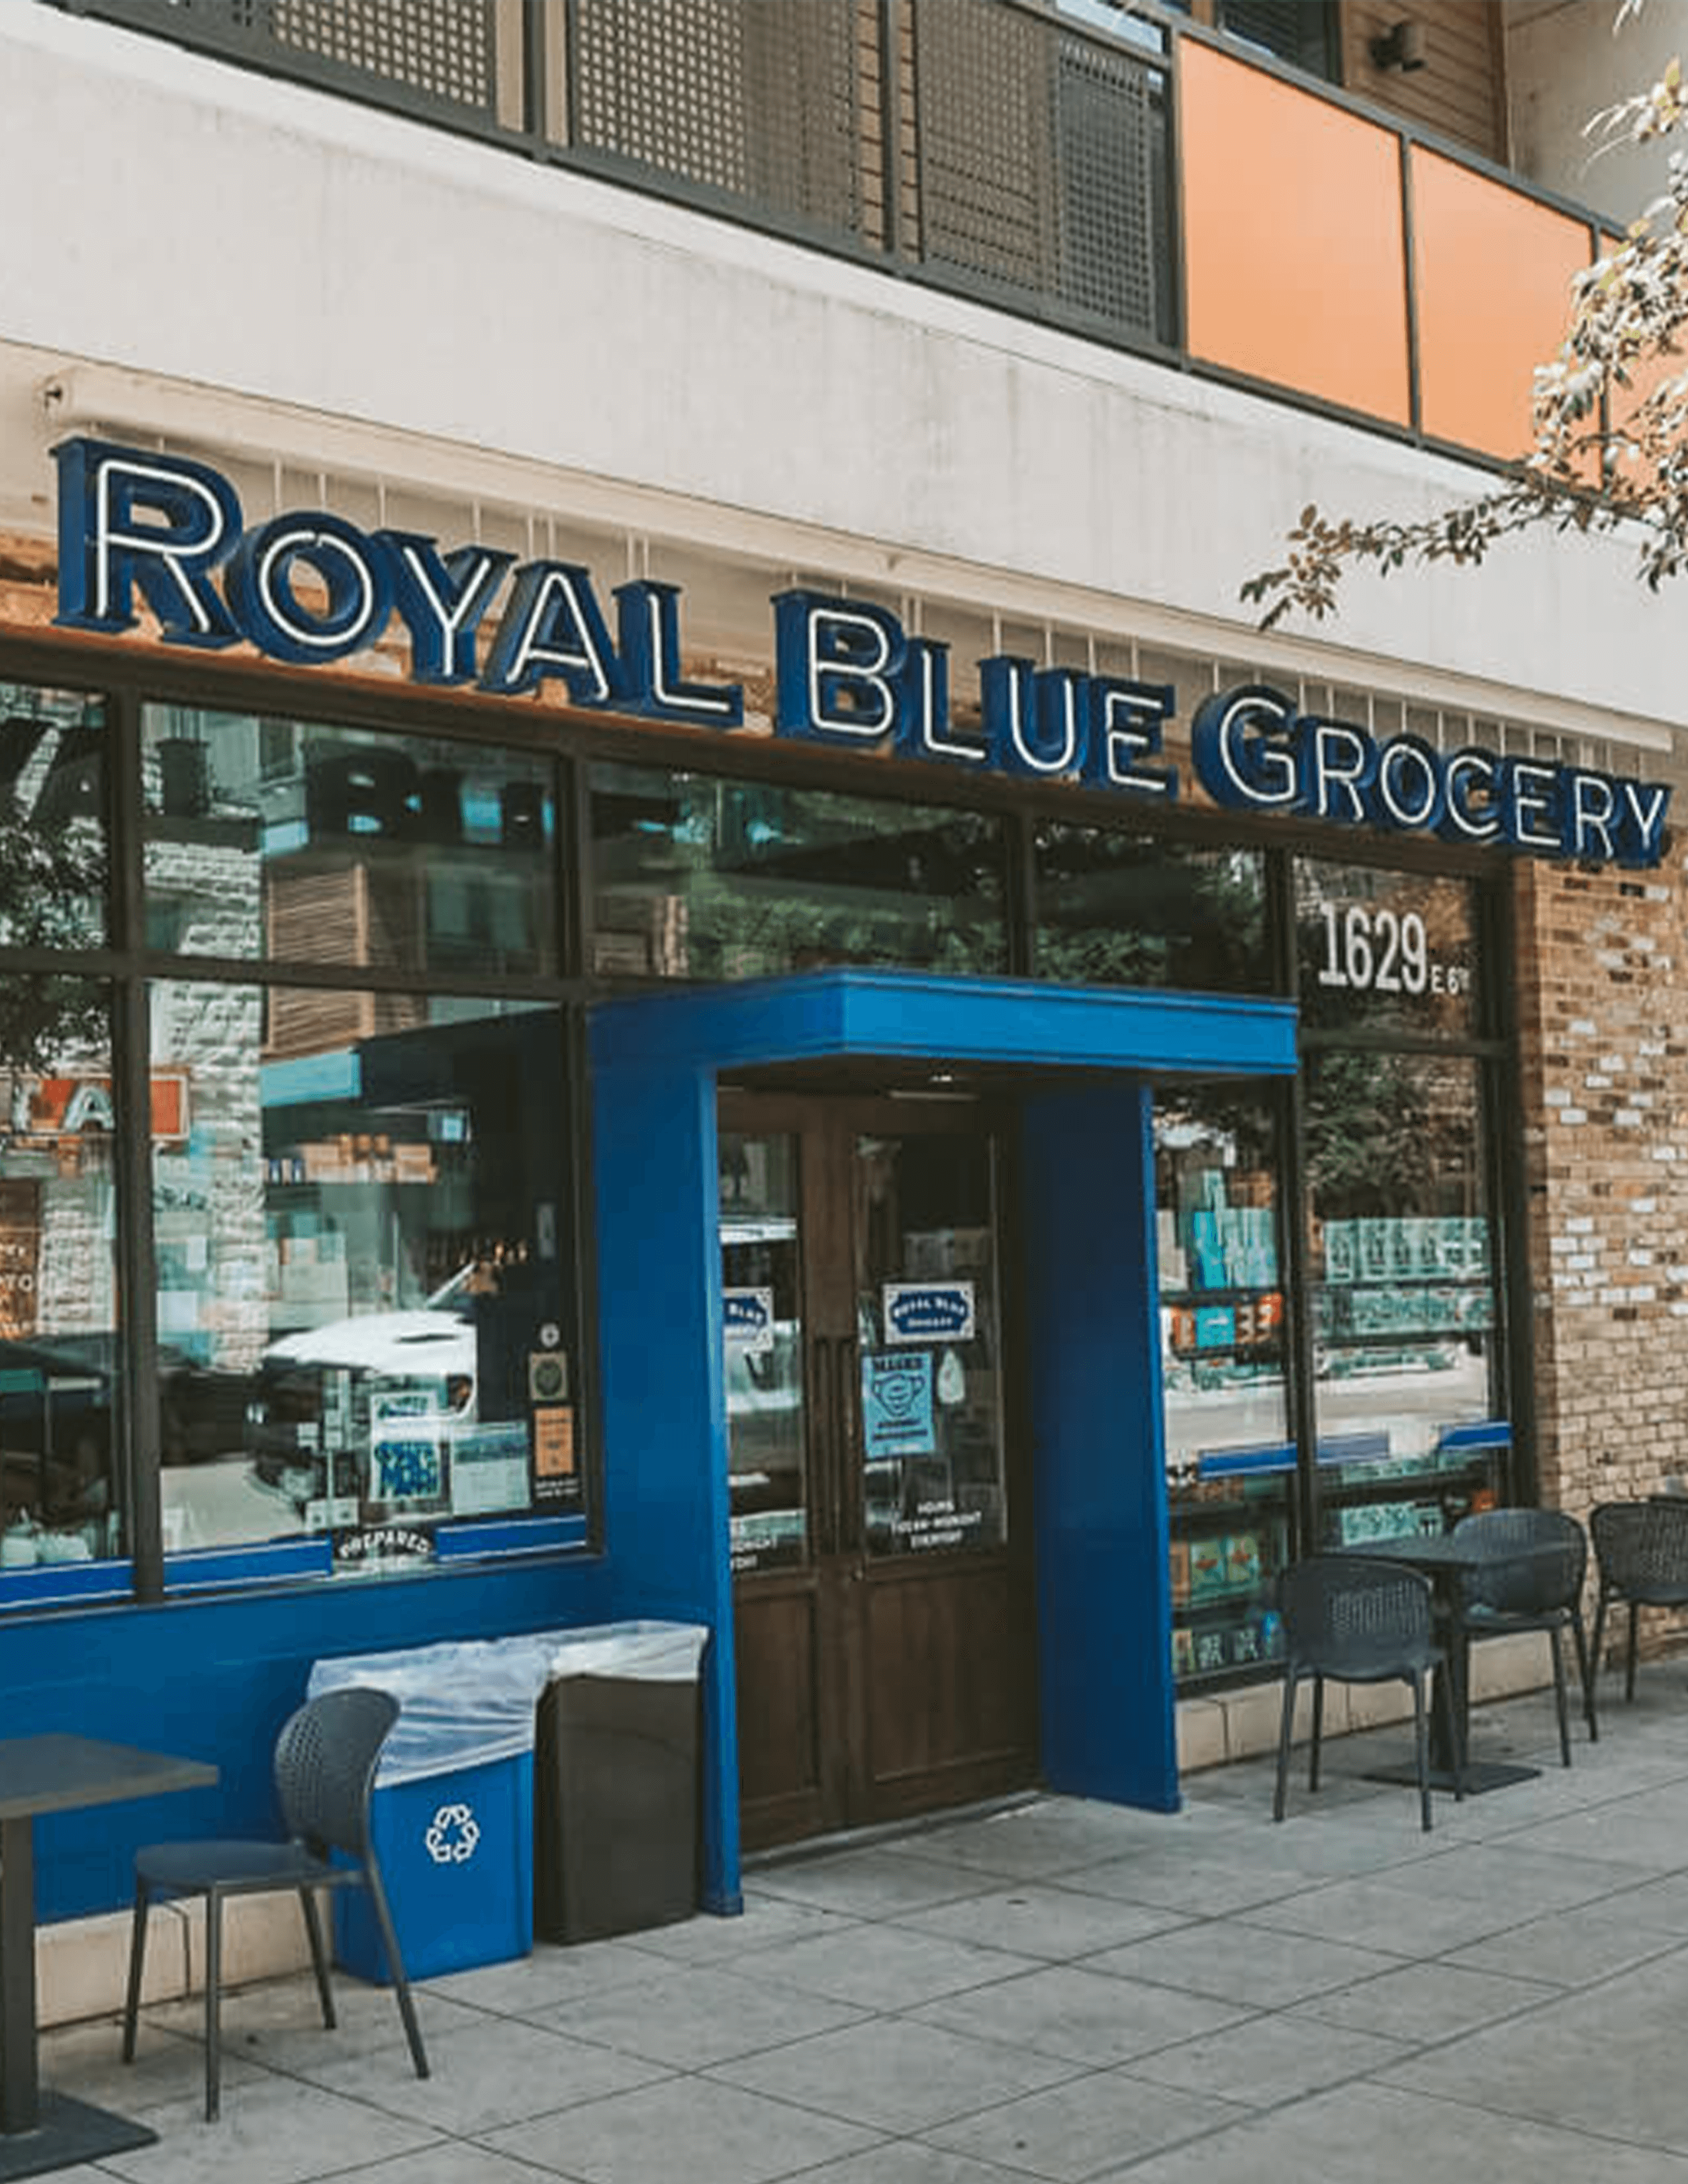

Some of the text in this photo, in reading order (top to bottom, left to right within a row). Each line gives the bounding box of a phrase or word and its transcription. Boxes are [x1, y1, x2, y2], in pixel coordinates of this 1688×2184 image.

[50, 437, 743, 727] ROYAL
[772, 588, 1177, 801] BLUE
[1193, 684, 1674, 869] GROCERY
[1318, 902, 1427, 994] 1629
[1431, 964, 1445, 994] E
